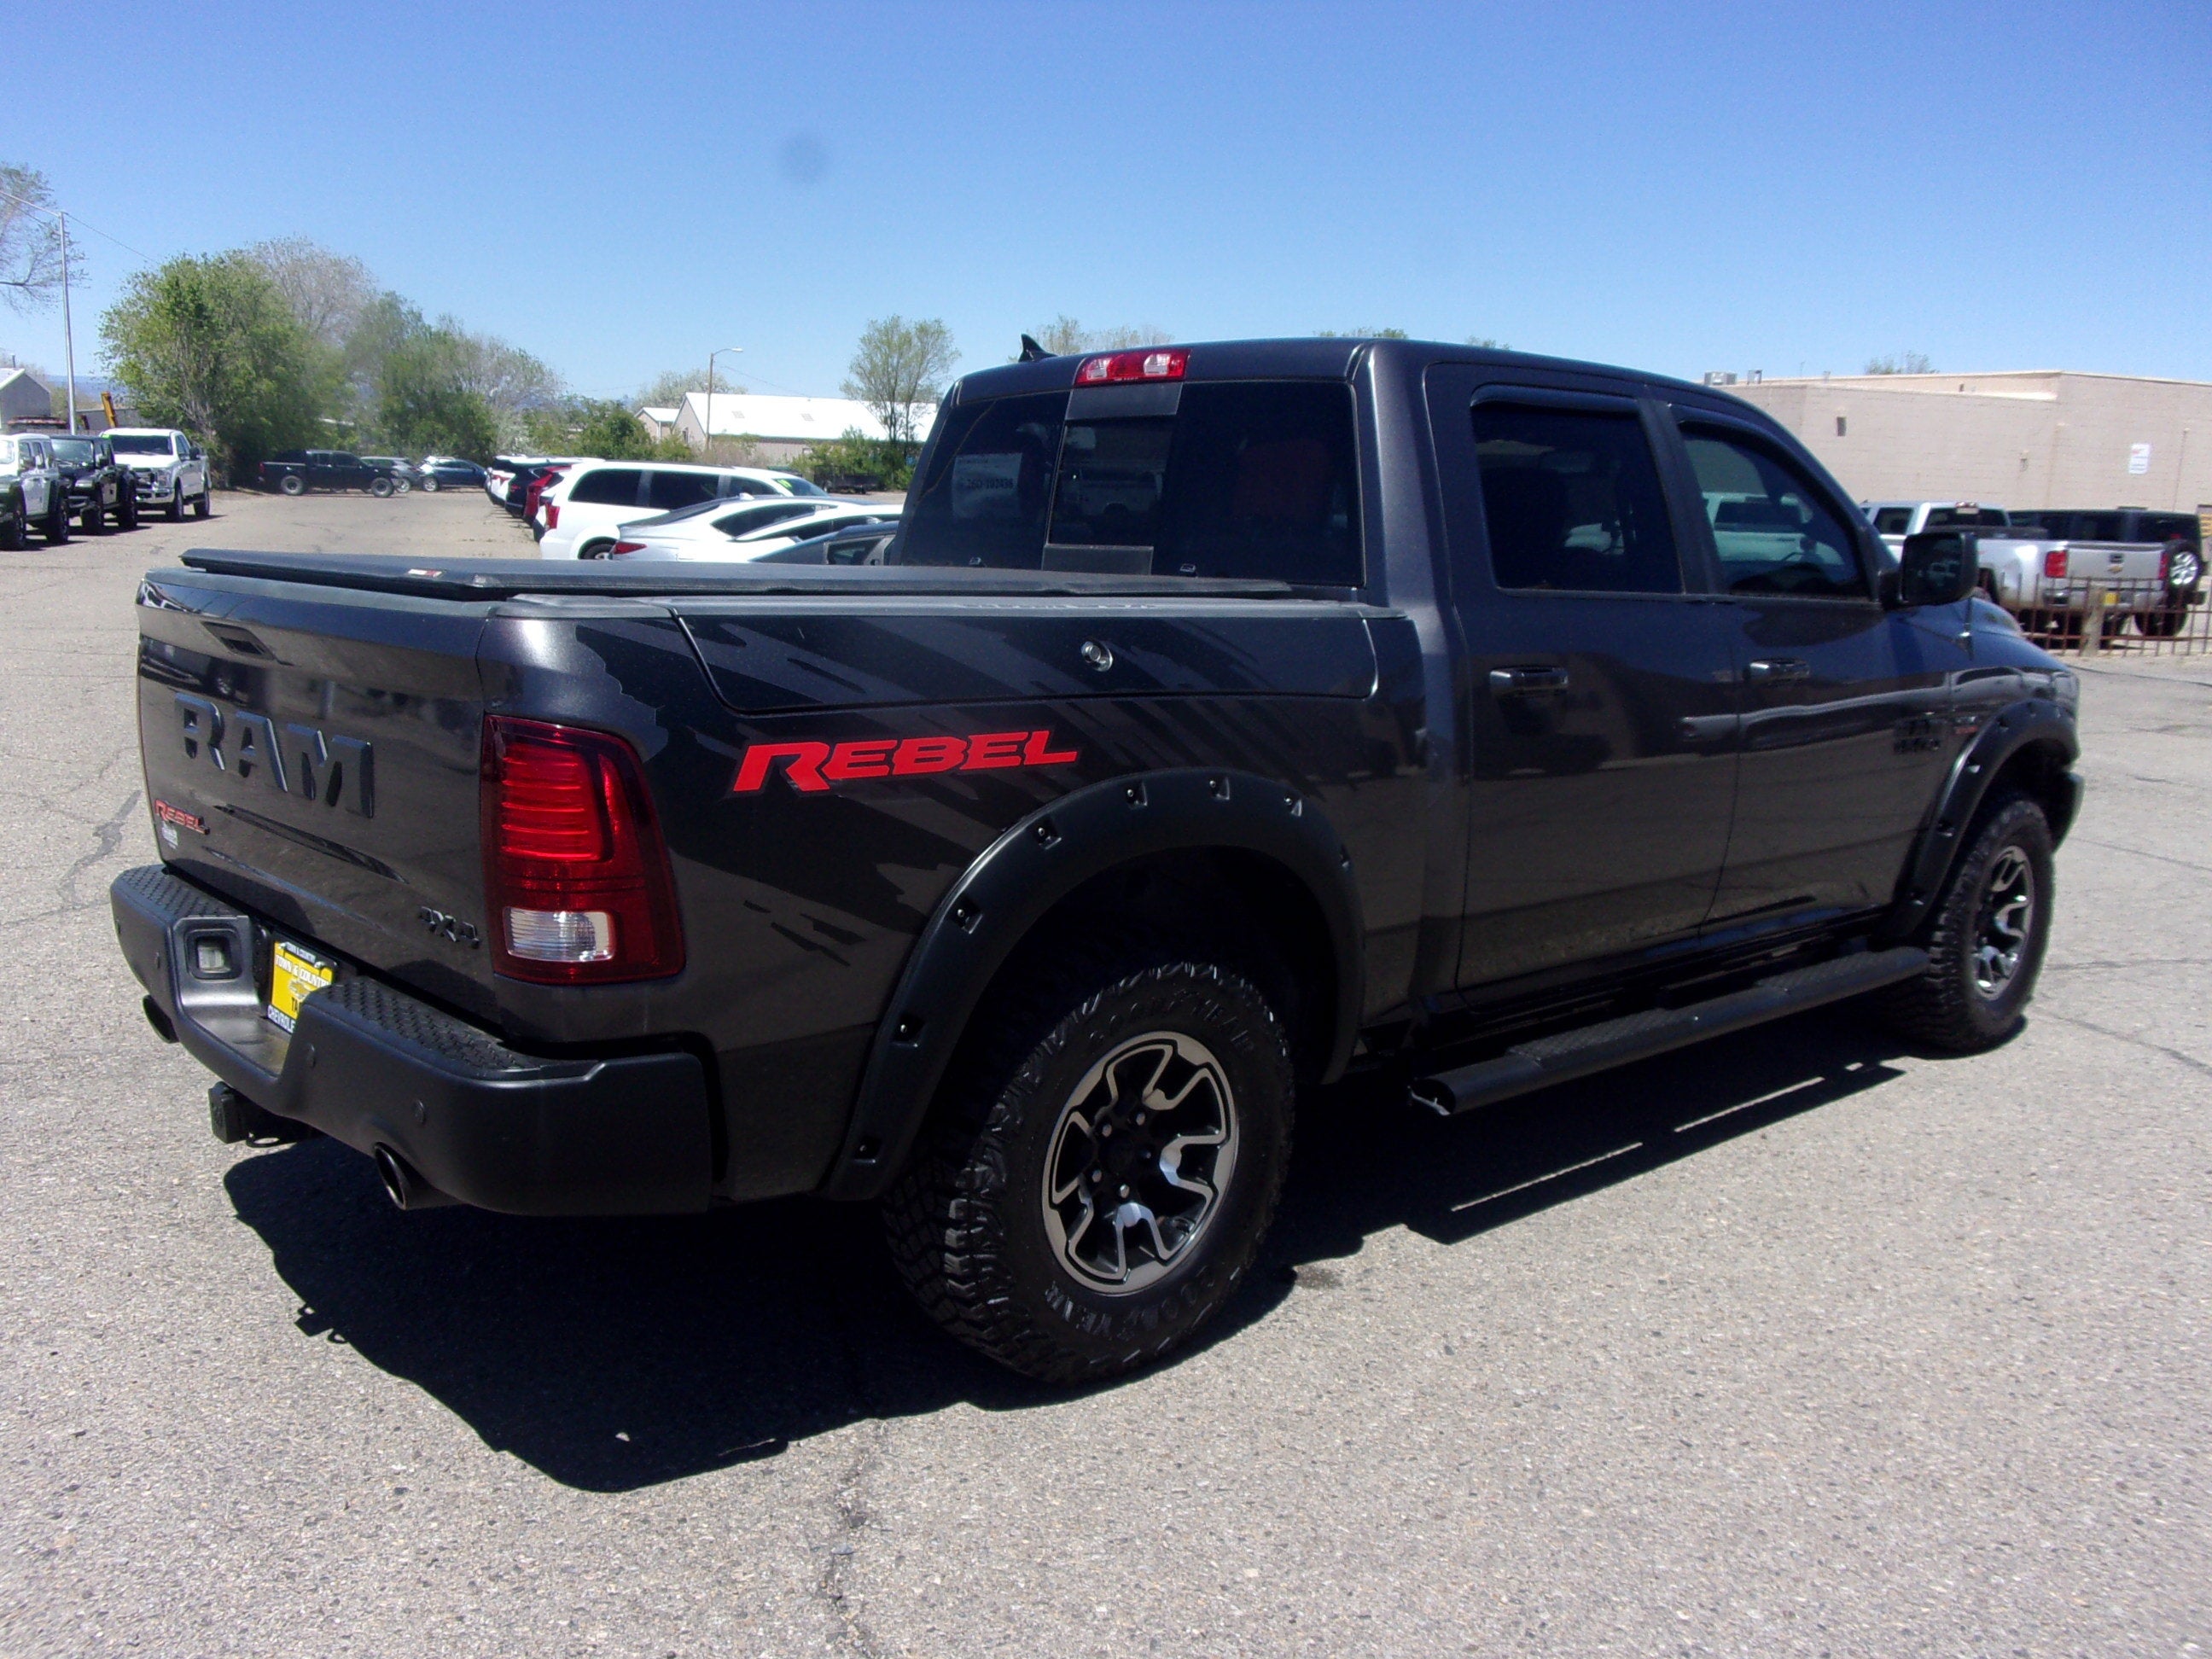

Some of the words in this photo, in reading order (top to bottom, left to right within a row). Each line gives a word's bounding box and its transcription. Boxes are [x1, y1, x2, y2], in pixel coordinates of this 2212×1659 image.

[175, 692, 375, 819] RAM
[733, 730, 1078, 792] REBEL
[154, 798, 210, 835] REBEL
[274, 954, 293, 974] TOWN
[292, 964, 300, 978] &
[267, 1004, 296, 1034] CHEVROLE
